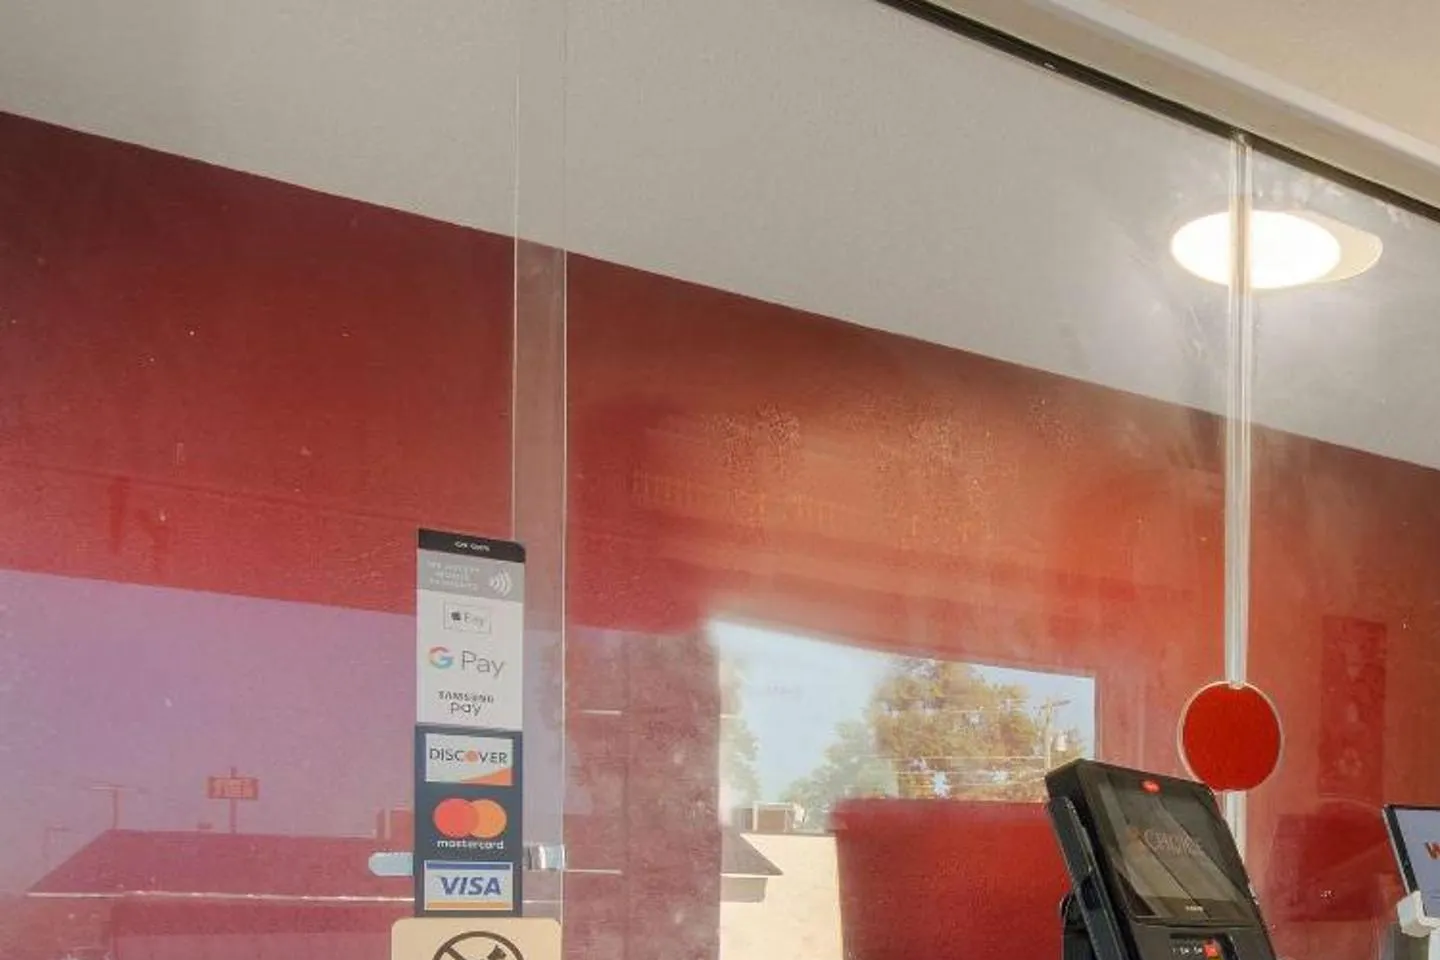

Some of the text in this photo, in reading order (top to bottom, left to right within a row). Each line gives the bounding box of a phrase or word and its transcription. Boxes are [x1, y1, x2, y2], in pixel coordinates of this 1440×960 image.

[461, 650, 505, 679] Pay
[438, 690, 495, 704] SAMSUNG
[450, 701, 482, 716] pay
[428, 748, 509, 764] DISCOVER
[436, 839, 505, 850] mastercard
[440, 876, 502, 896] VISA
